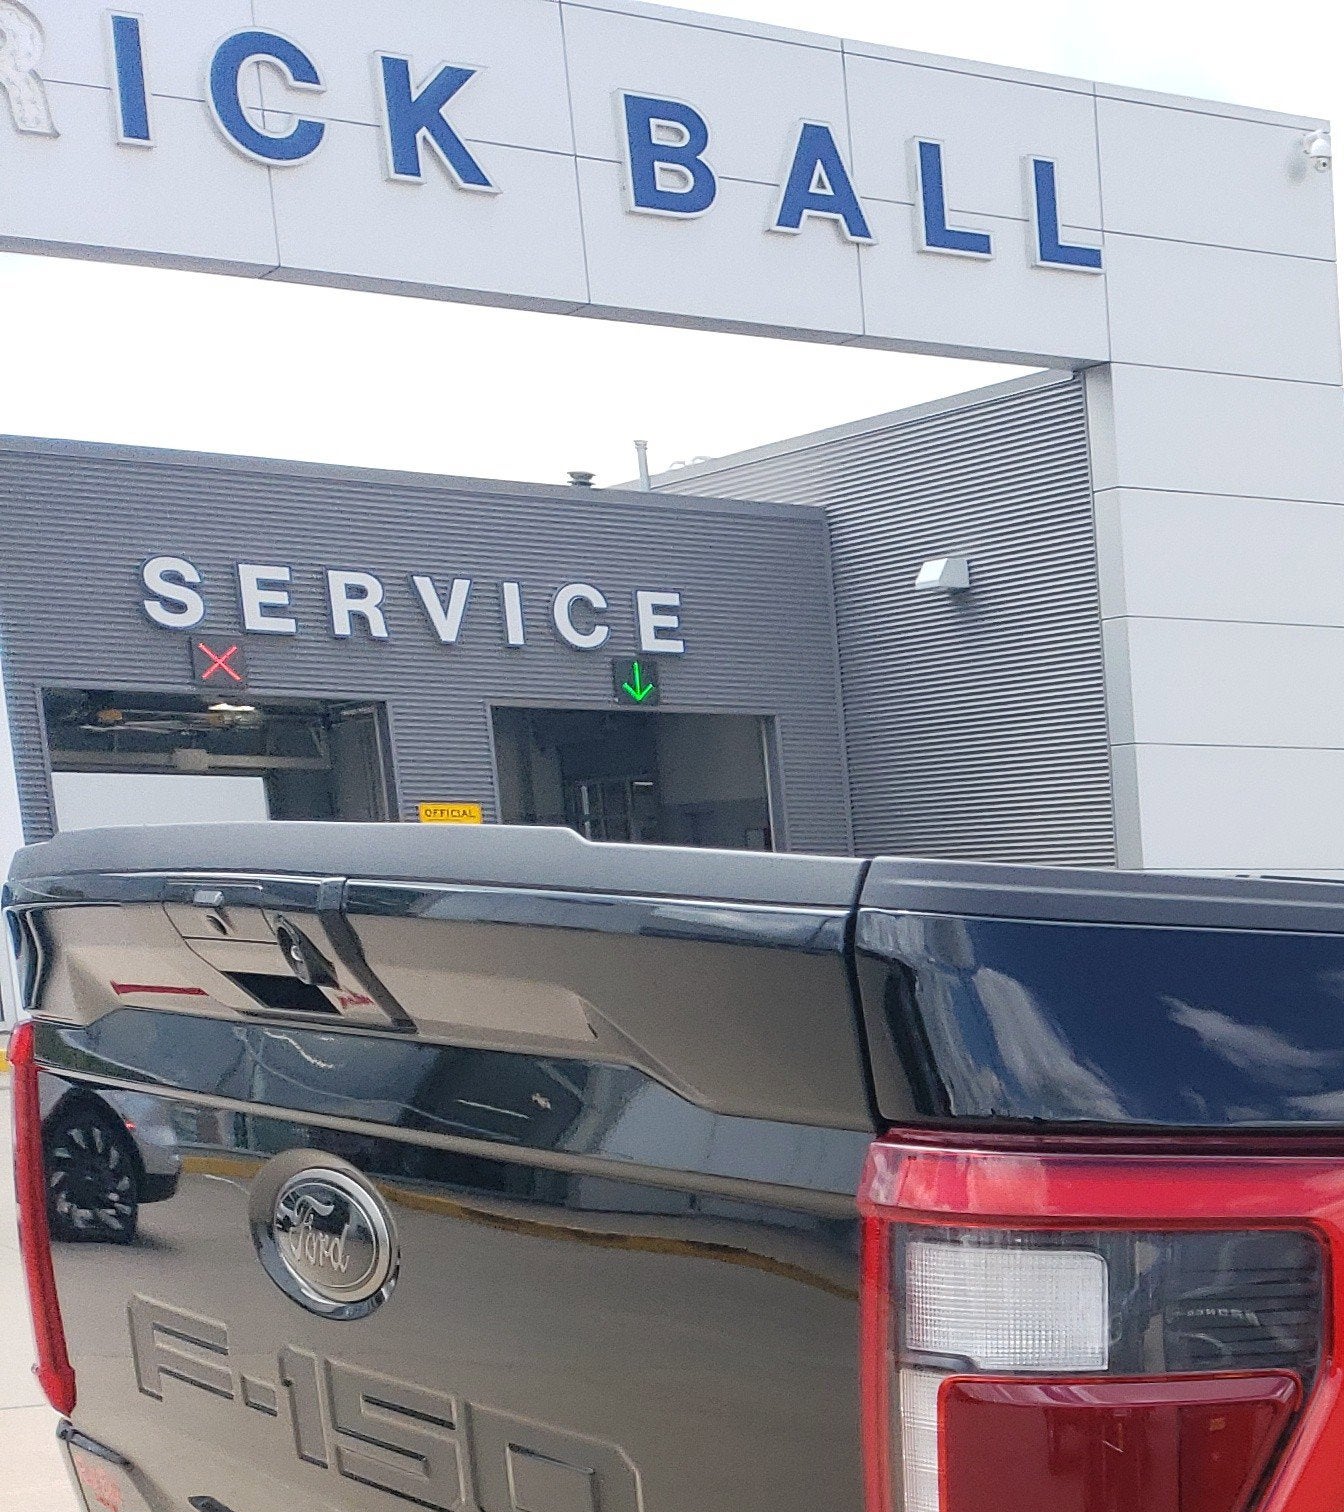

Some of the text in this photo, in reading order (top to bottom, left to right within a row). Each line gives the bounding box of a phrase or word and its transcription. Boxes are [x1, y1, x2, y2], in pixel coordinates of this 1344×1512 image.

[616, 90, 1105, 274] BALL
[140, 554, 688, 657] SERVICE
[424, 808, 477, 819] OFFICIAL
